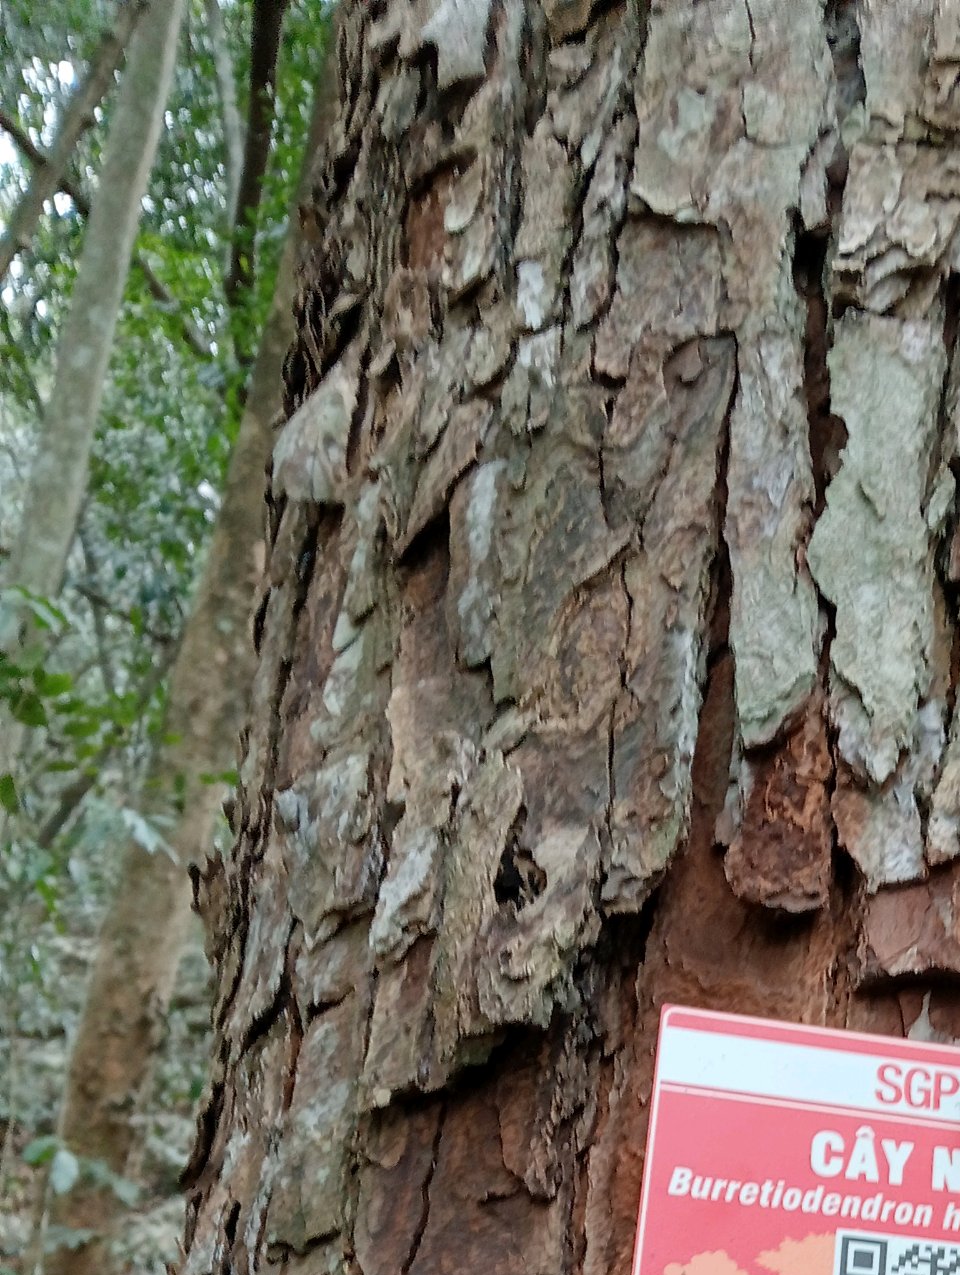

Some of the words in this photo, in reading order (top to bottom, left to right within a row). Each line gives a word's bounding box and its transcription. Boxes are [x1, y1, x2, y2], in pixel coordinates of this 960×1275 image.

[875, 1064, 960, 1112] SGP
[809, 1125, 915, 1186] CÂY
[668, 1166, 934, 1228] Burretiodendron
